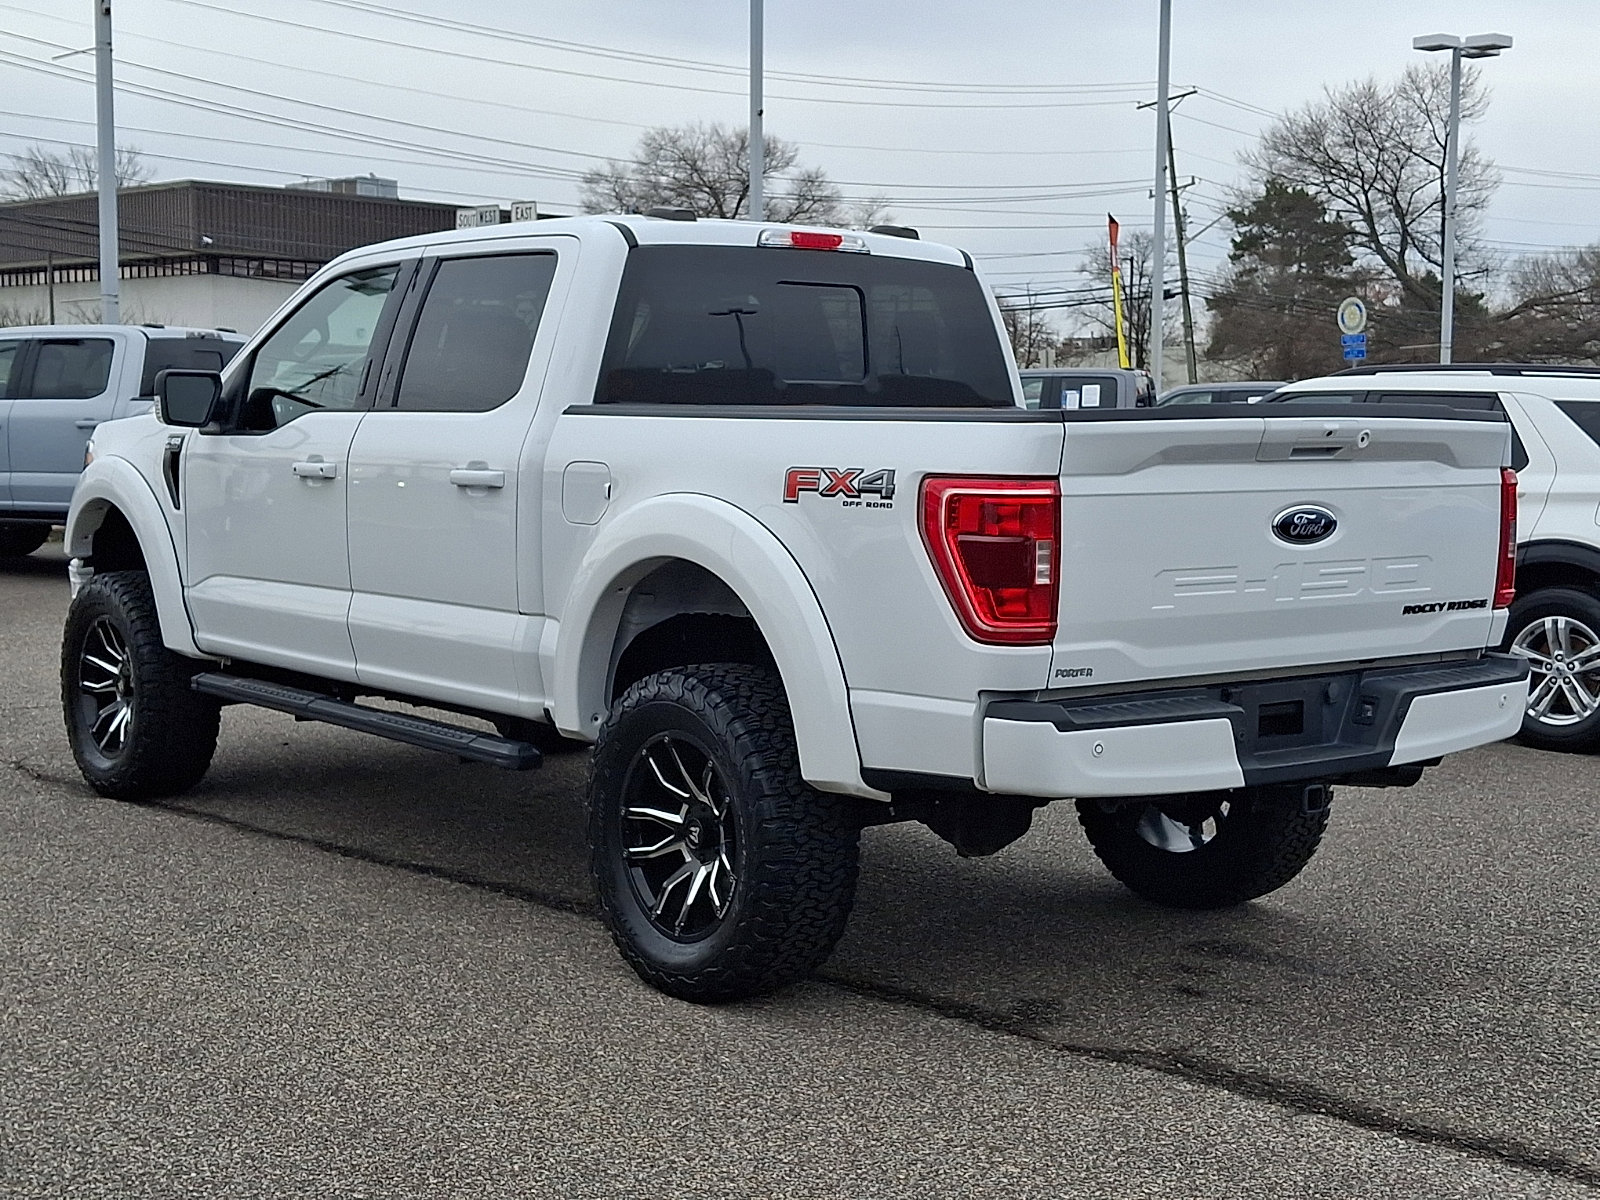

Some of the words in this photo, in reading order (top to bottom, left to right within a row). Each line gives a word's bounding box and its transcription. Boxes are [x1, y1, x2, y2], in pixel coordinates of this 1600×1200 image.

[458, 213, 476, 227] SOUT
[479, 210, 496, 223] WEST
[515, 206, 532, 220] EAST
[783, 466, 896, 504] FX4
[842, 500, 862, 508] OFF
[865, 501, 893, 509] ROAD
[1290, 513, 1325, 536] Ford
[1151, 555, 1434, 610] F-150
[1402, 602, 1446, 615] ROCKY
[1447, 598, 1488, 612] RIDGE
[1054, 667, 1093, 678] PORTER
